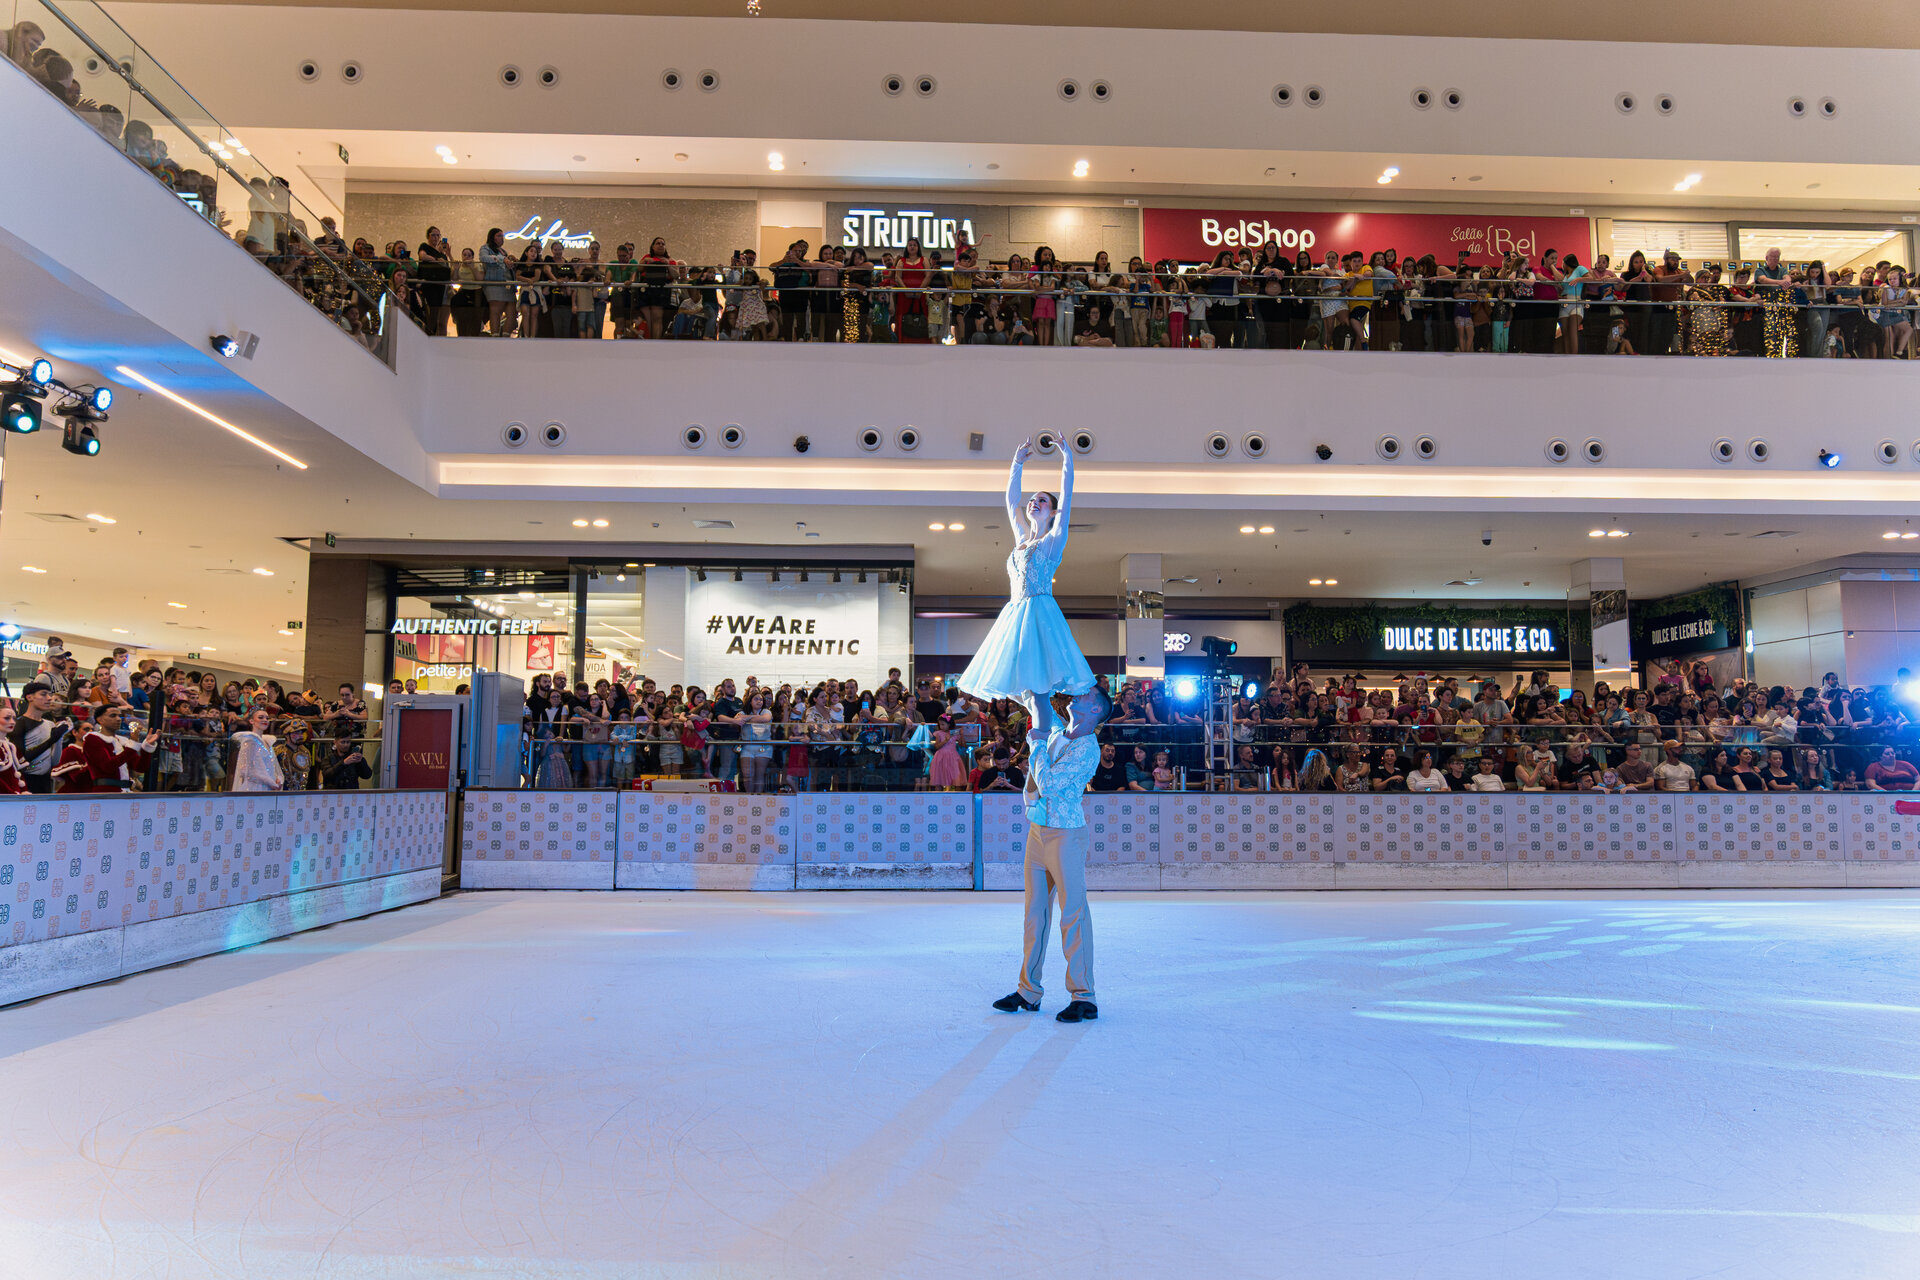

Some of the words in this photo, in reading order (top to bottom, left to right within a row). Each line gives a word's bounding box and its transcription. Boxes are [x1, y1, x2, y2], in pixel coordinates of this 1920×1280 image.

[1201, 218, 1316, 251] BelShop
[1450, 226, 1485, 242] Salão
[1467, 241, 1483, 254] da
[391, 618, 498, 635] AUTHENTIC
[1652, 627, 1670, 645] DULCE
[1670, 626, 1679, 641] DE
[1679, 621, 1698, 640] LECHE
[1698, 619, 1705, 638] &
[1384, 626, 1435, 651] DULCE
[1438, 627, 1460, 651] DE
[1462, 627, 1513, 652] LECHE
[1514, 626, 1528, 653] &
[1529, 627, 1557, 652] CO.
[416, 664, 457, 680] petite
[585, 663, 606, 672] VIDA
[403, 752, 448, 766] NATAL
